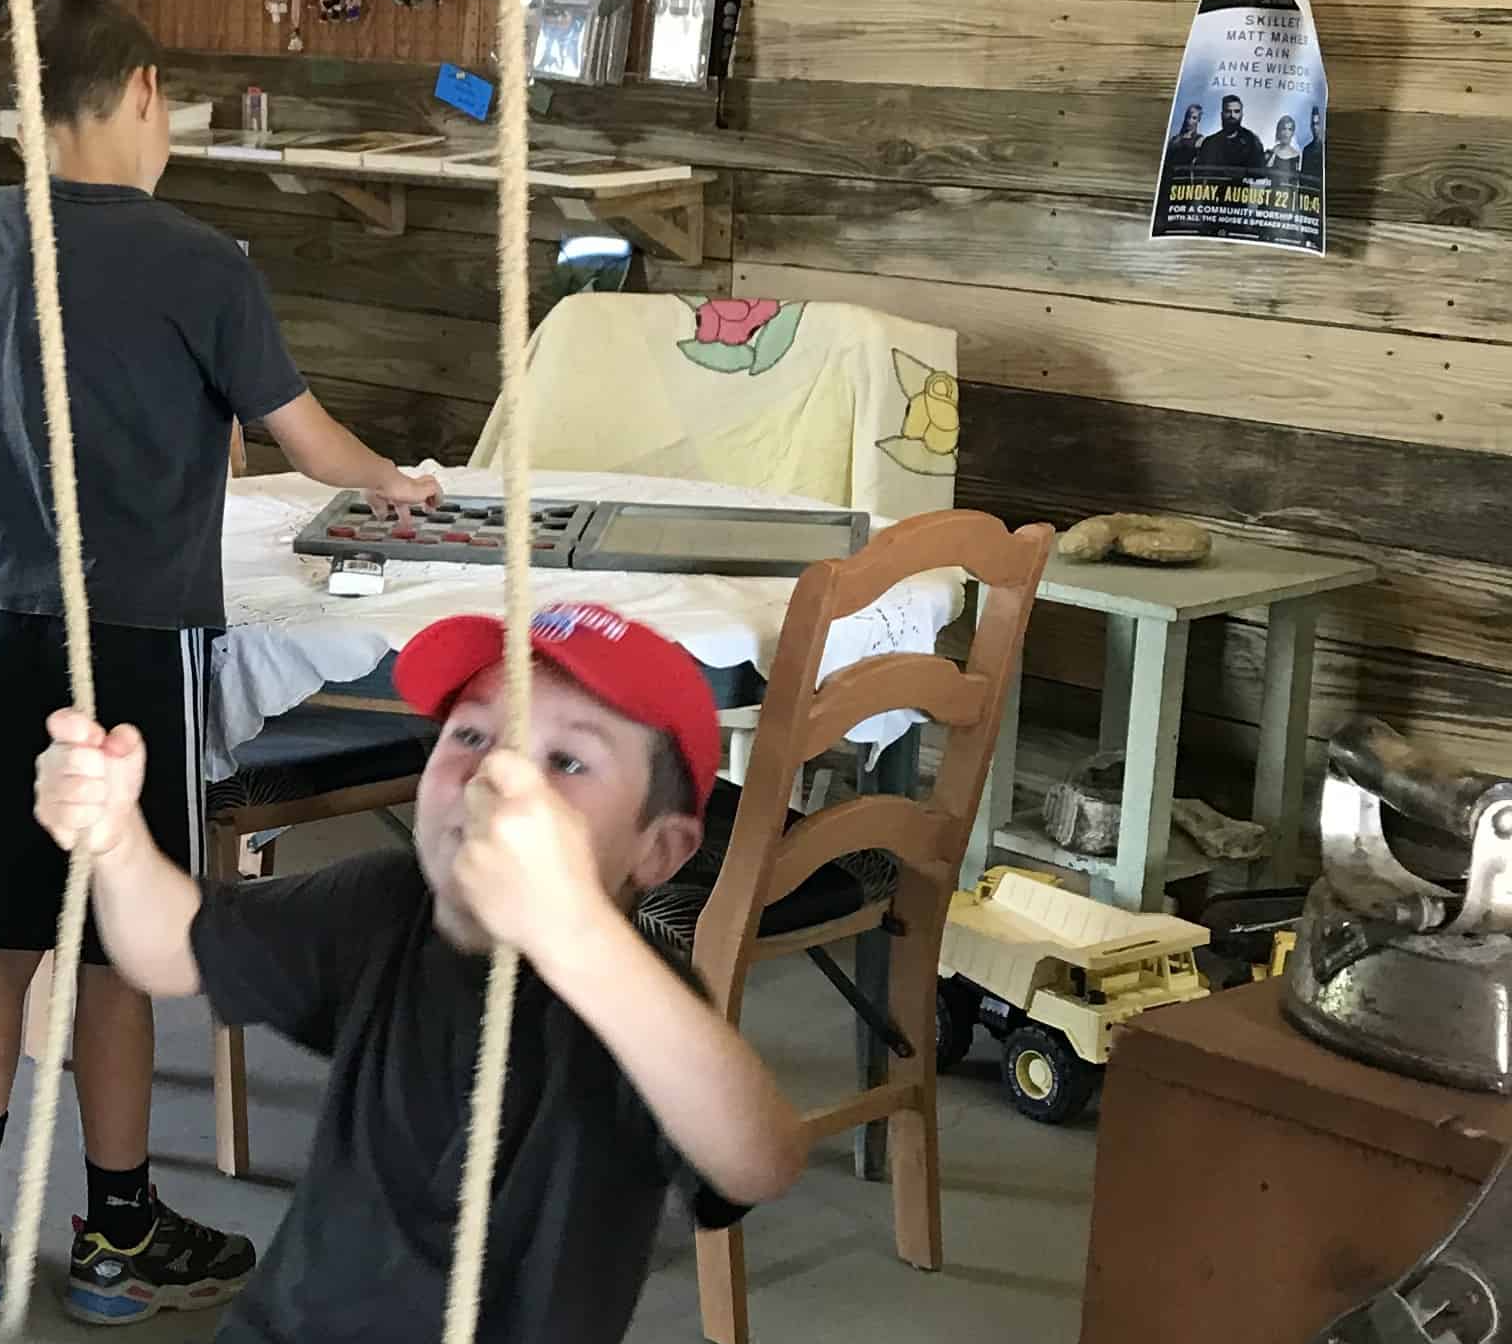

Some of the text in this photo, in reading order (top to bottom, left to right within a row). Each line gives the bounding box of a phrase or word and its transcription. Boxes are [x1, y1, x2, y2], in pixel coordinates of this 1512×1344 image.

[1226, 30, 1264, 42] MATT
[1254, 46, 1291, 58] CAIN
[1218, 61, 1261, 73] ANNE
[1211, 76, 1313, 93] ALL THE NOISE
[1169, 184, 1219, 203] SUNDAY,
[1224, 186, 1272, 205] AUGUST
[1275, 190, 1289, 208] 22
[1168, 205, 1186, 213] FOR
[1188, 205, 1195, 213] A
[1196, 205, 1253, 218] COMMUNITY
